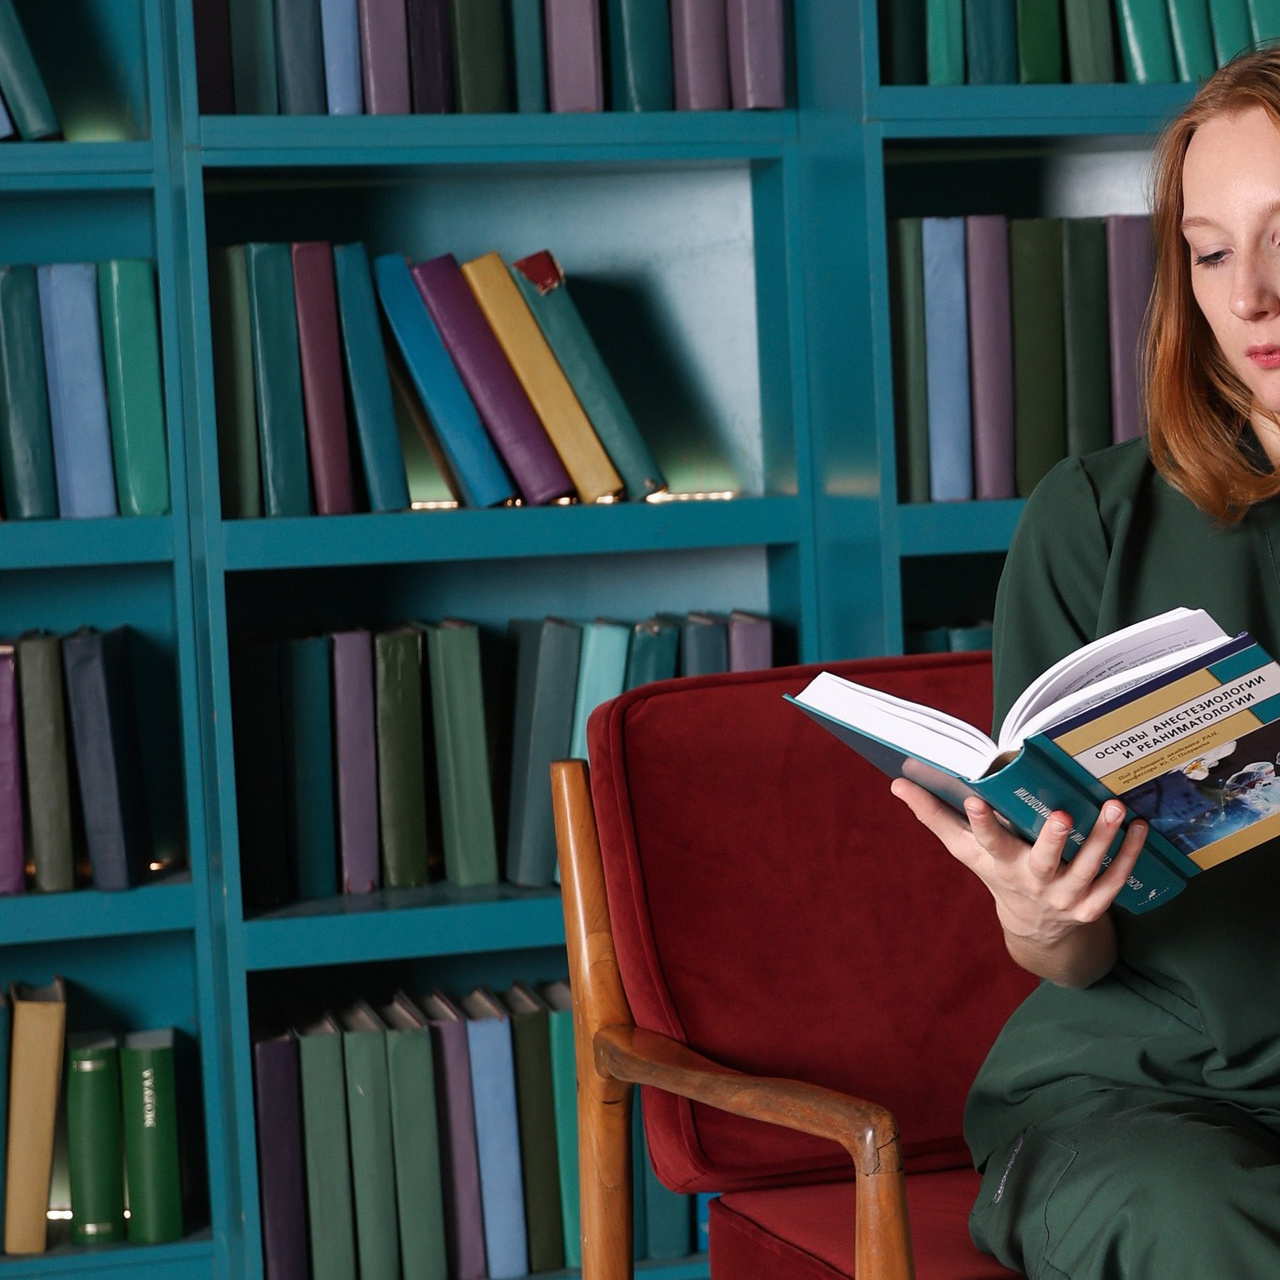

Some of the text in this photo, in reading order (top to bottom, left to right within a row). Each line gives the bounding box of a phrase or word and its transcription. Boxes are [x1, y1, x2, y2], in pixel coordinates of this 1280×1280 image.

[1095, 730, 1149, 760] ОСНОВЫ
[1153, 675, 1266, 733] АНЕСТЕЗИОЛОГИИ
[1122, 750, 1134, 760] И
[1138, 693, 1256, 752] РЕАНИМАТОЛОГИИ
